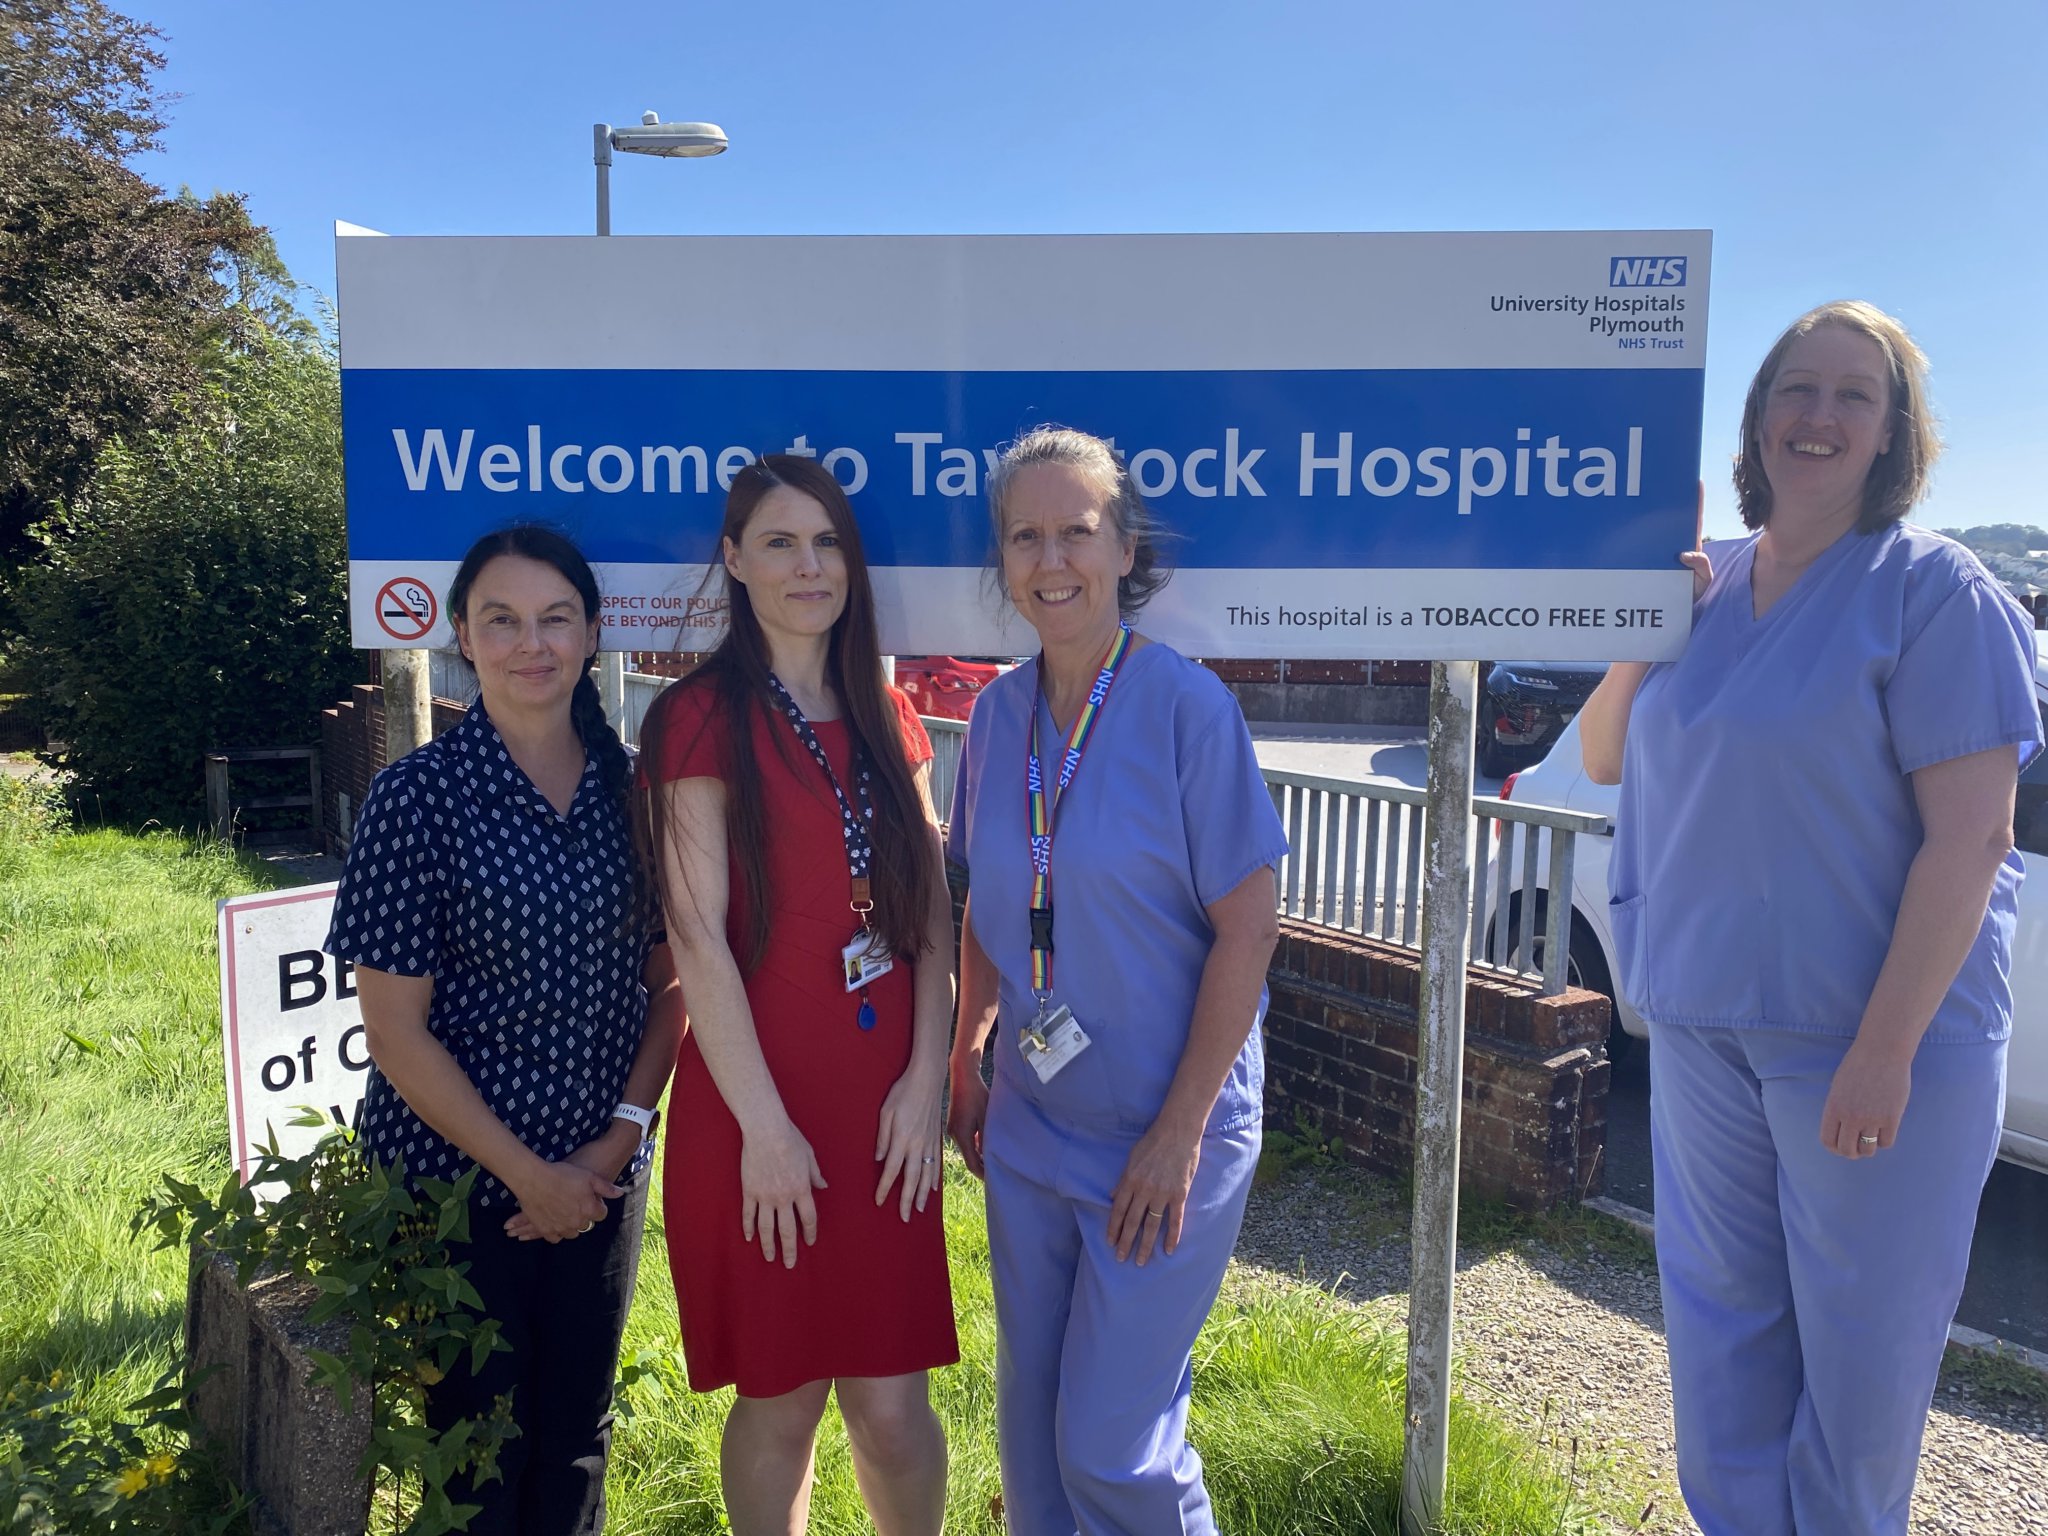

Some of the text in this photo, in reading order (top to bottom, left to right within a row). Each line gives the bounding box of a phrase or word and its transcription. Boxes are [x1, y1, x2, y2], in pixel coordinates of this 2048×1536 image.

[1612, 258, 1685, 286] NHS
[1490, 294, 1686, 316] University Hospitals
[1589, 315, 1685, 336] Plymouth
[1618, 337, 1685, 349] NHS Trust
[391, 424, 757, 494] Welcome
[1299, 426, 1644, 515] Hospital
[651, 597, 682, 609] OUR
[687, 598, 730, 610] POLIC
[620, 615, 681, 627] BEYOND
[685, 616, 716, 628] THIS
[1226, 605, 1664, 631] This hospital is a TOBACCO FREE SITE
[1089, 668, 1114, 705] NHS
[1028, 755, 1042, 793] NHS
[1059, 748, 1081, 788] NHS
[261, 1035, 317, 1092] of
